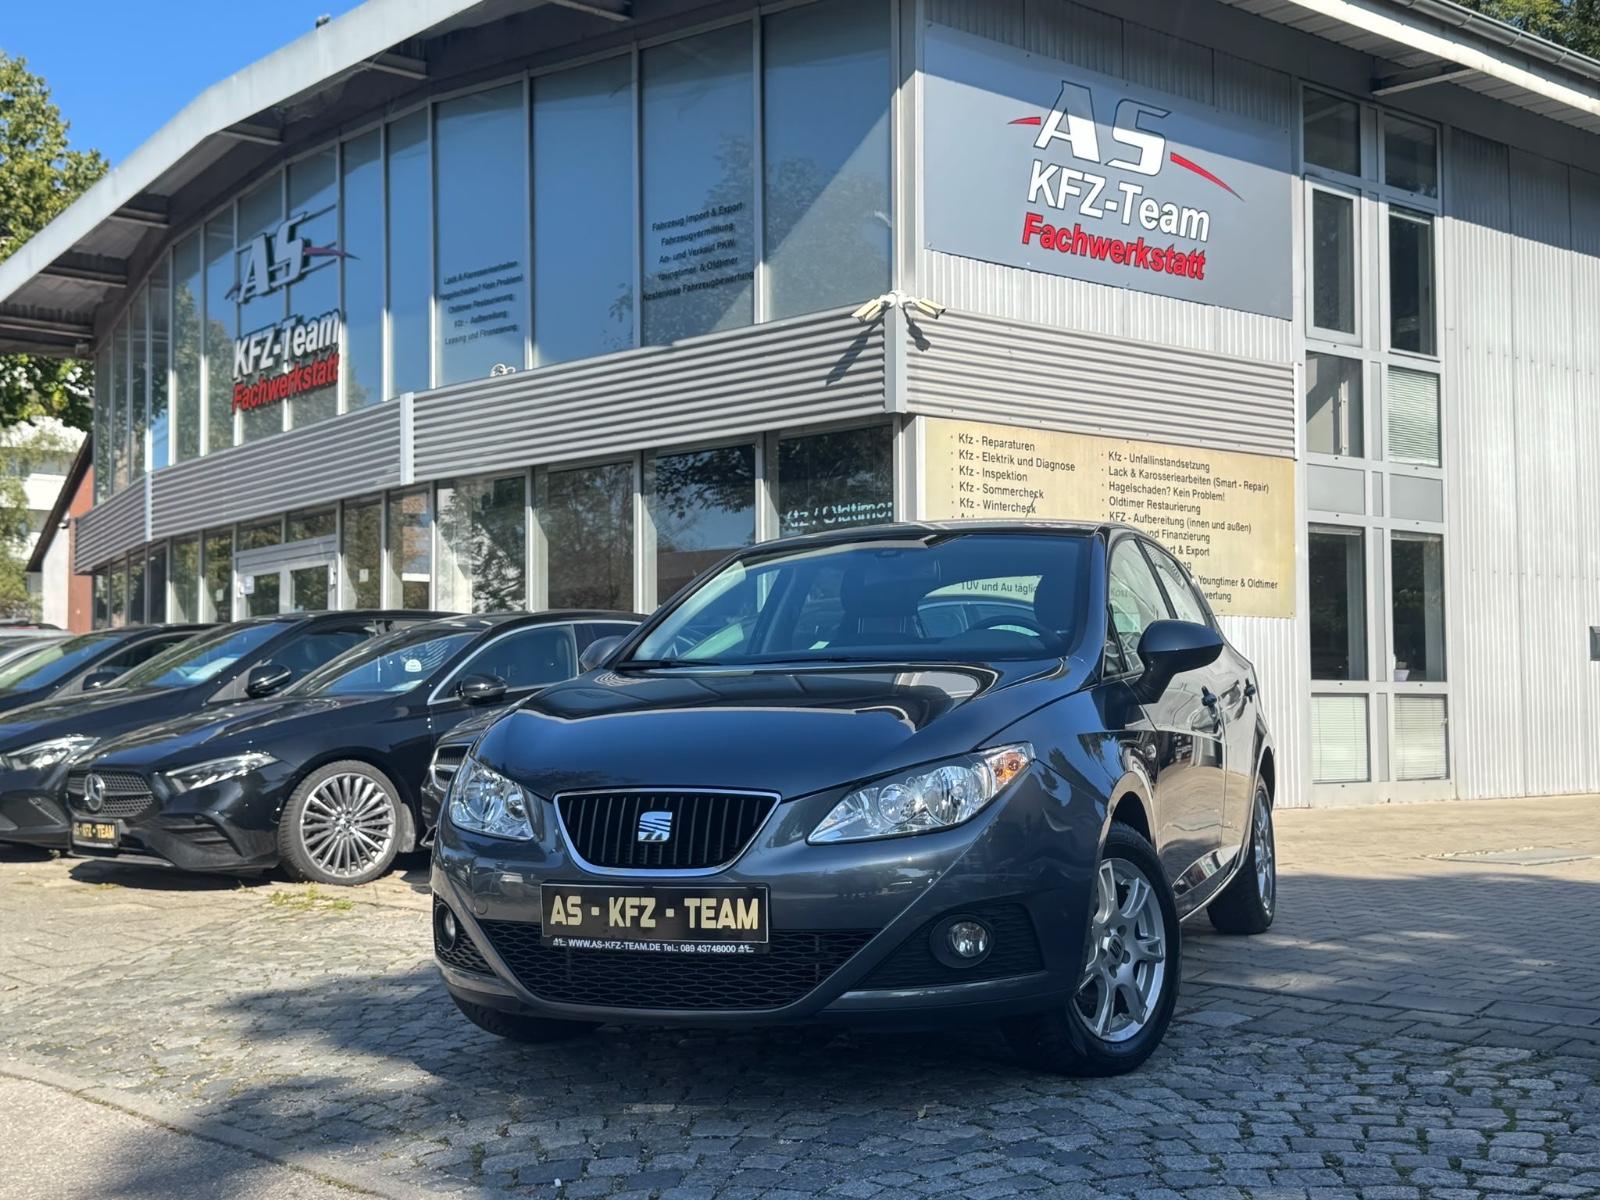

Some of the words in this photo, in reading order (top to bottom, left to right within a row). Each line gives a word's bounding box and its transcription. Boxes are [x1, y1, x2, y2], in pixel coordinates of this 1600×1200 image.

[1033, 80, 1172, 176] AS
[1027, 158, 1210, 242] KFZ-Team
[1022, 211, 1206, 280] Fachwerkstatt
[231, 211, 311, 305] AS
[233, 309, 341, 380] KFZ-Team
[232, 353, 340, 414] Fachwerkstatt
[958, 433, 974, 445] Kfz
[982, 436, 1035, 451] Reparaturen
[959, 449, 974, 461] Kfz
[982, 452, 1015, 465] Elektrik
[1018, 457, 1034, 467] und
[1036, 458, 1076, 472] Diagnose
[1108, 451, 1122, 462] Kfz
[1129, 453, 1210, 473] Unfallinstandsetzung
[959, 465, 974, 477] Kfz
[982, 468, 1028, 482] Inspektion
[1108, 467, 1128, 478] Lack
[1130, 469, 1136, 478] &
[1139, 469, 1211, 486] Karosseriearbeiten
[1213, 477, 1237, 489] (Smart
[1243, 481, 1269, 494] Repair)
[959, 481, 974, 493] Kfz
[982, 483, 1044, 499] Sommercheck
[1109, 481, 1171, 495] Hagelschaden?
[1173, 489, 1190, 499] Kein
[1192, 490, 1225, 501] Problem!
[960, 497, 975, 509] Kfz
[983, 500, 1036, 513] Wintercheck
[1109, 496, 1144, 508] Oldtimer
[1147, 499, 1201, 515] Restaurierung
[1109, 511, 1126, 523] KFZ
[1133, 513, 1185, 528] Aufbereitung
[1187, 518, 1210, 530] (innen
[1211, 520, 1226, 530] und
[1227, 522, 1252, 534] außen)
[1162, 529, 1211, 544] Finanzierung
[1178, 546, 1184, 555] &
[1186, 545, 1210, 558] Export
[982, 582, 999, 592] und
[1001, 582, 1013, 592] Au
[1198, 575, 1238, 588] Youngtimer
[1240, 578, 1245, 588] &
[1248, 578, 1278, 589] Oldtimer
[550, 895, 582, 926] AS
[608, 896, 656, 928] KFZ
[684, 897, 759, 930] TEAM
[568, 938, 661, 951] WWW.AS-KFZ-TEAM.DE
[680, 944, 695, 953] 089
